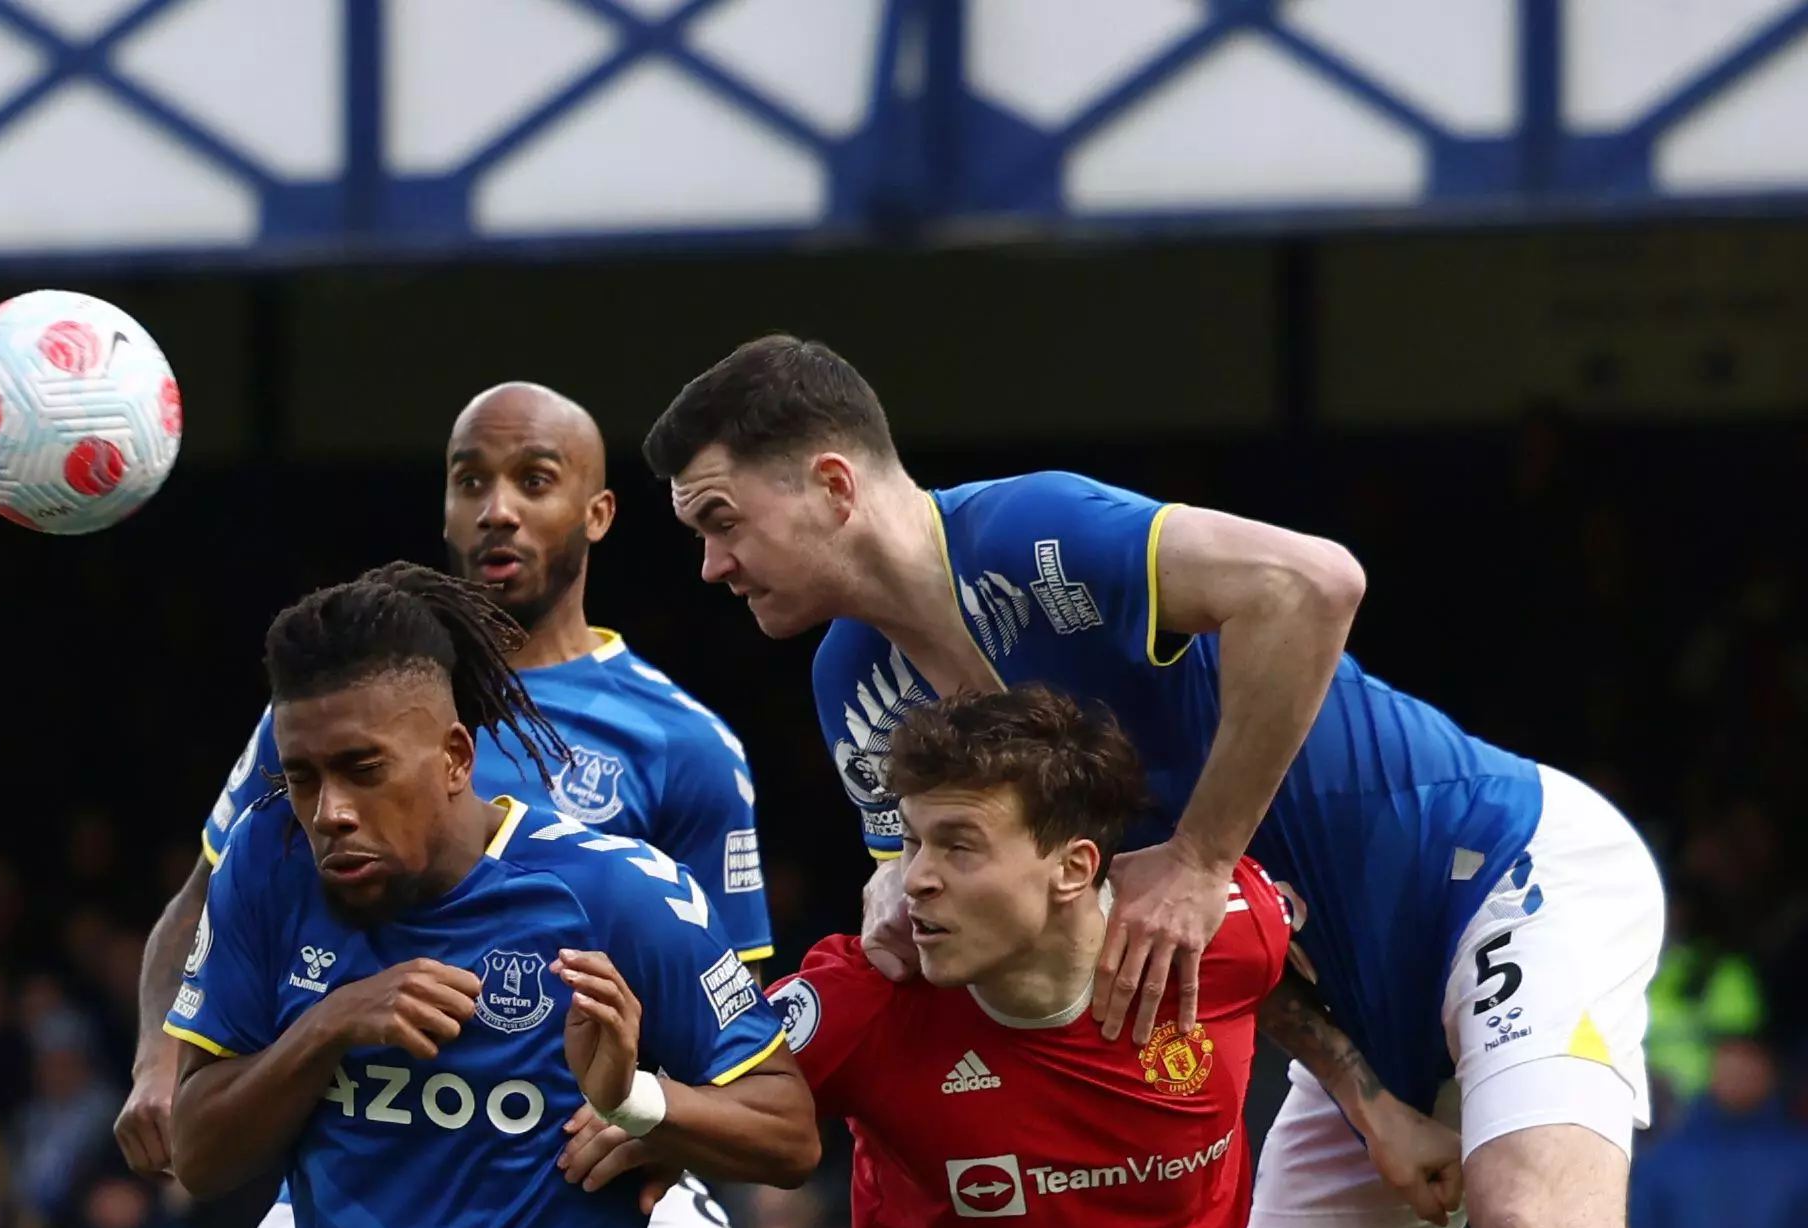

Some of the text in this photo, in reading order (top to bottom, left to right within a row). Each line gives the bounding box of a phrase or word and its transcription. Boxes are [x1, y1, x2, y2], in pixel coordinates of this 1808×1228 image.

[1473, 930, 1523, 1016] 5
[489, 992, 532, 1008] Everton
[720, 989, 753, 1022] APPEAL
[1484, 1025, 1533, 1053] hummel
[941, 1073, 1002, 1095] adidas
[1168, 1067, 1208, 1094] UNITED
[1026, 1129, 1234, 1195] TeamViewer
